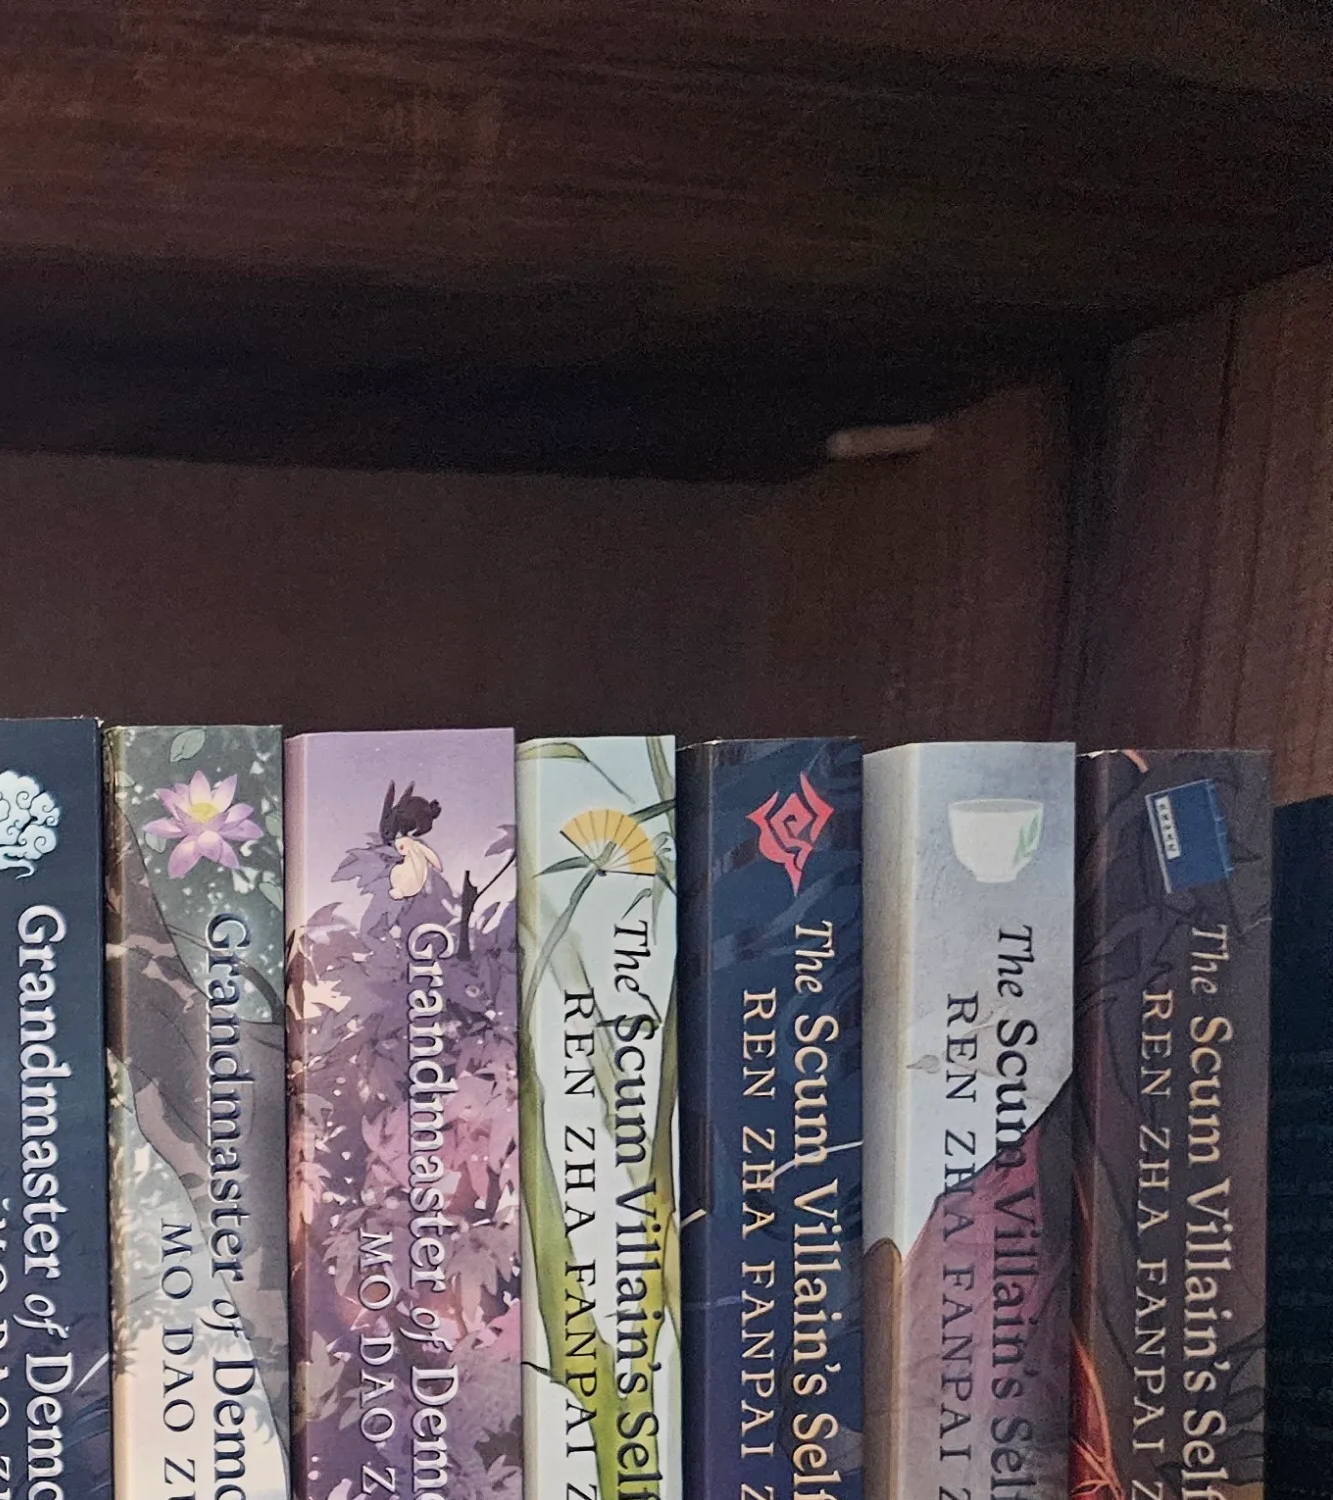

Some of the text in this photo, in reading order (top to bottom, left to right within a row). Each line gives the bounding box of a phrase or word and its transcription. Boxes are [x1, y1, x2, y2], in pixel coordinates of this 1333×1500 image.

[613, 920, 652, 993] The
[794, 921, 834, 994] The
[18, 905, 72, 1280] Grandmaster
[613, 1014, 659, 1167] Scum
[743, 988, 777, 1099] REN
[794, 1014, 839, 1168] Scum
[742, 1126, 776, 1238] ZHA
[14, 1299, 69, 1341] of
[740, 1261, 775, 1459] FANPAI
